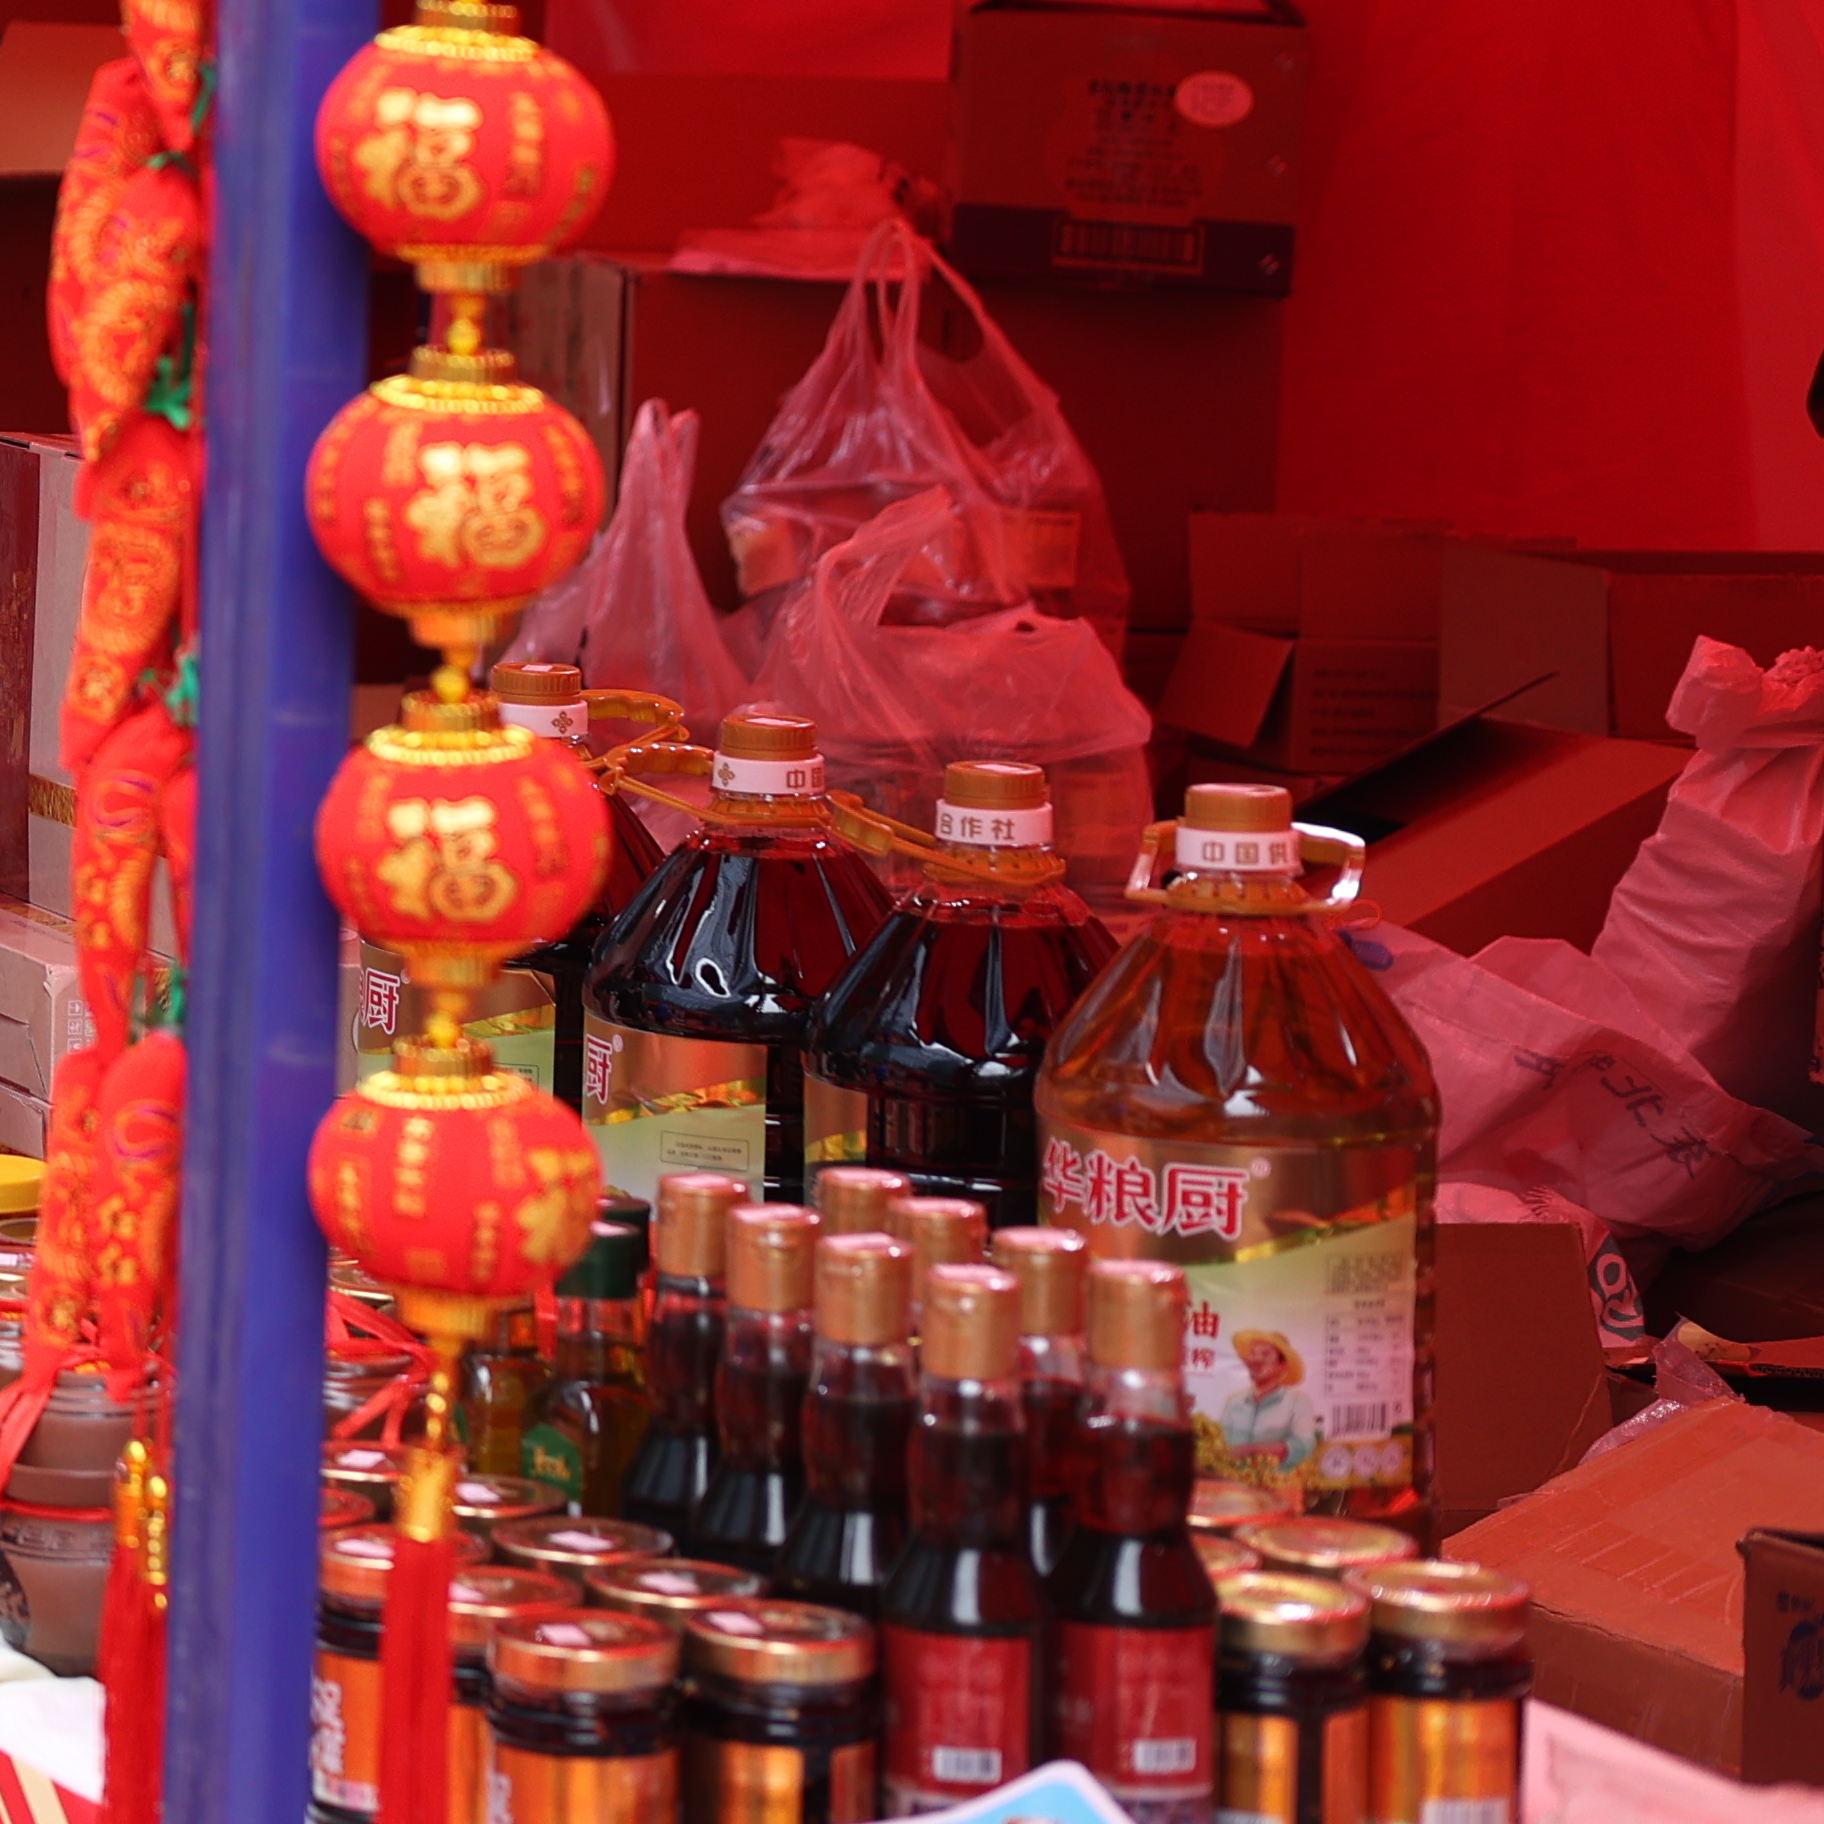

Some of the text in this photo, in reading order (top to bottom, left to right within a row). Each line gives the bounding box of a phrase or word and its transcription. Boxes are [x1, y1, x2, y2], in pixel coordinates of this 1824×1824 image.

[354, 88, 482, 220] 福
[406, 442, 545, 569] 福
[377, 798, 515, 924] 福
[1043, 1135, 1250, 1240] 华粮厨
